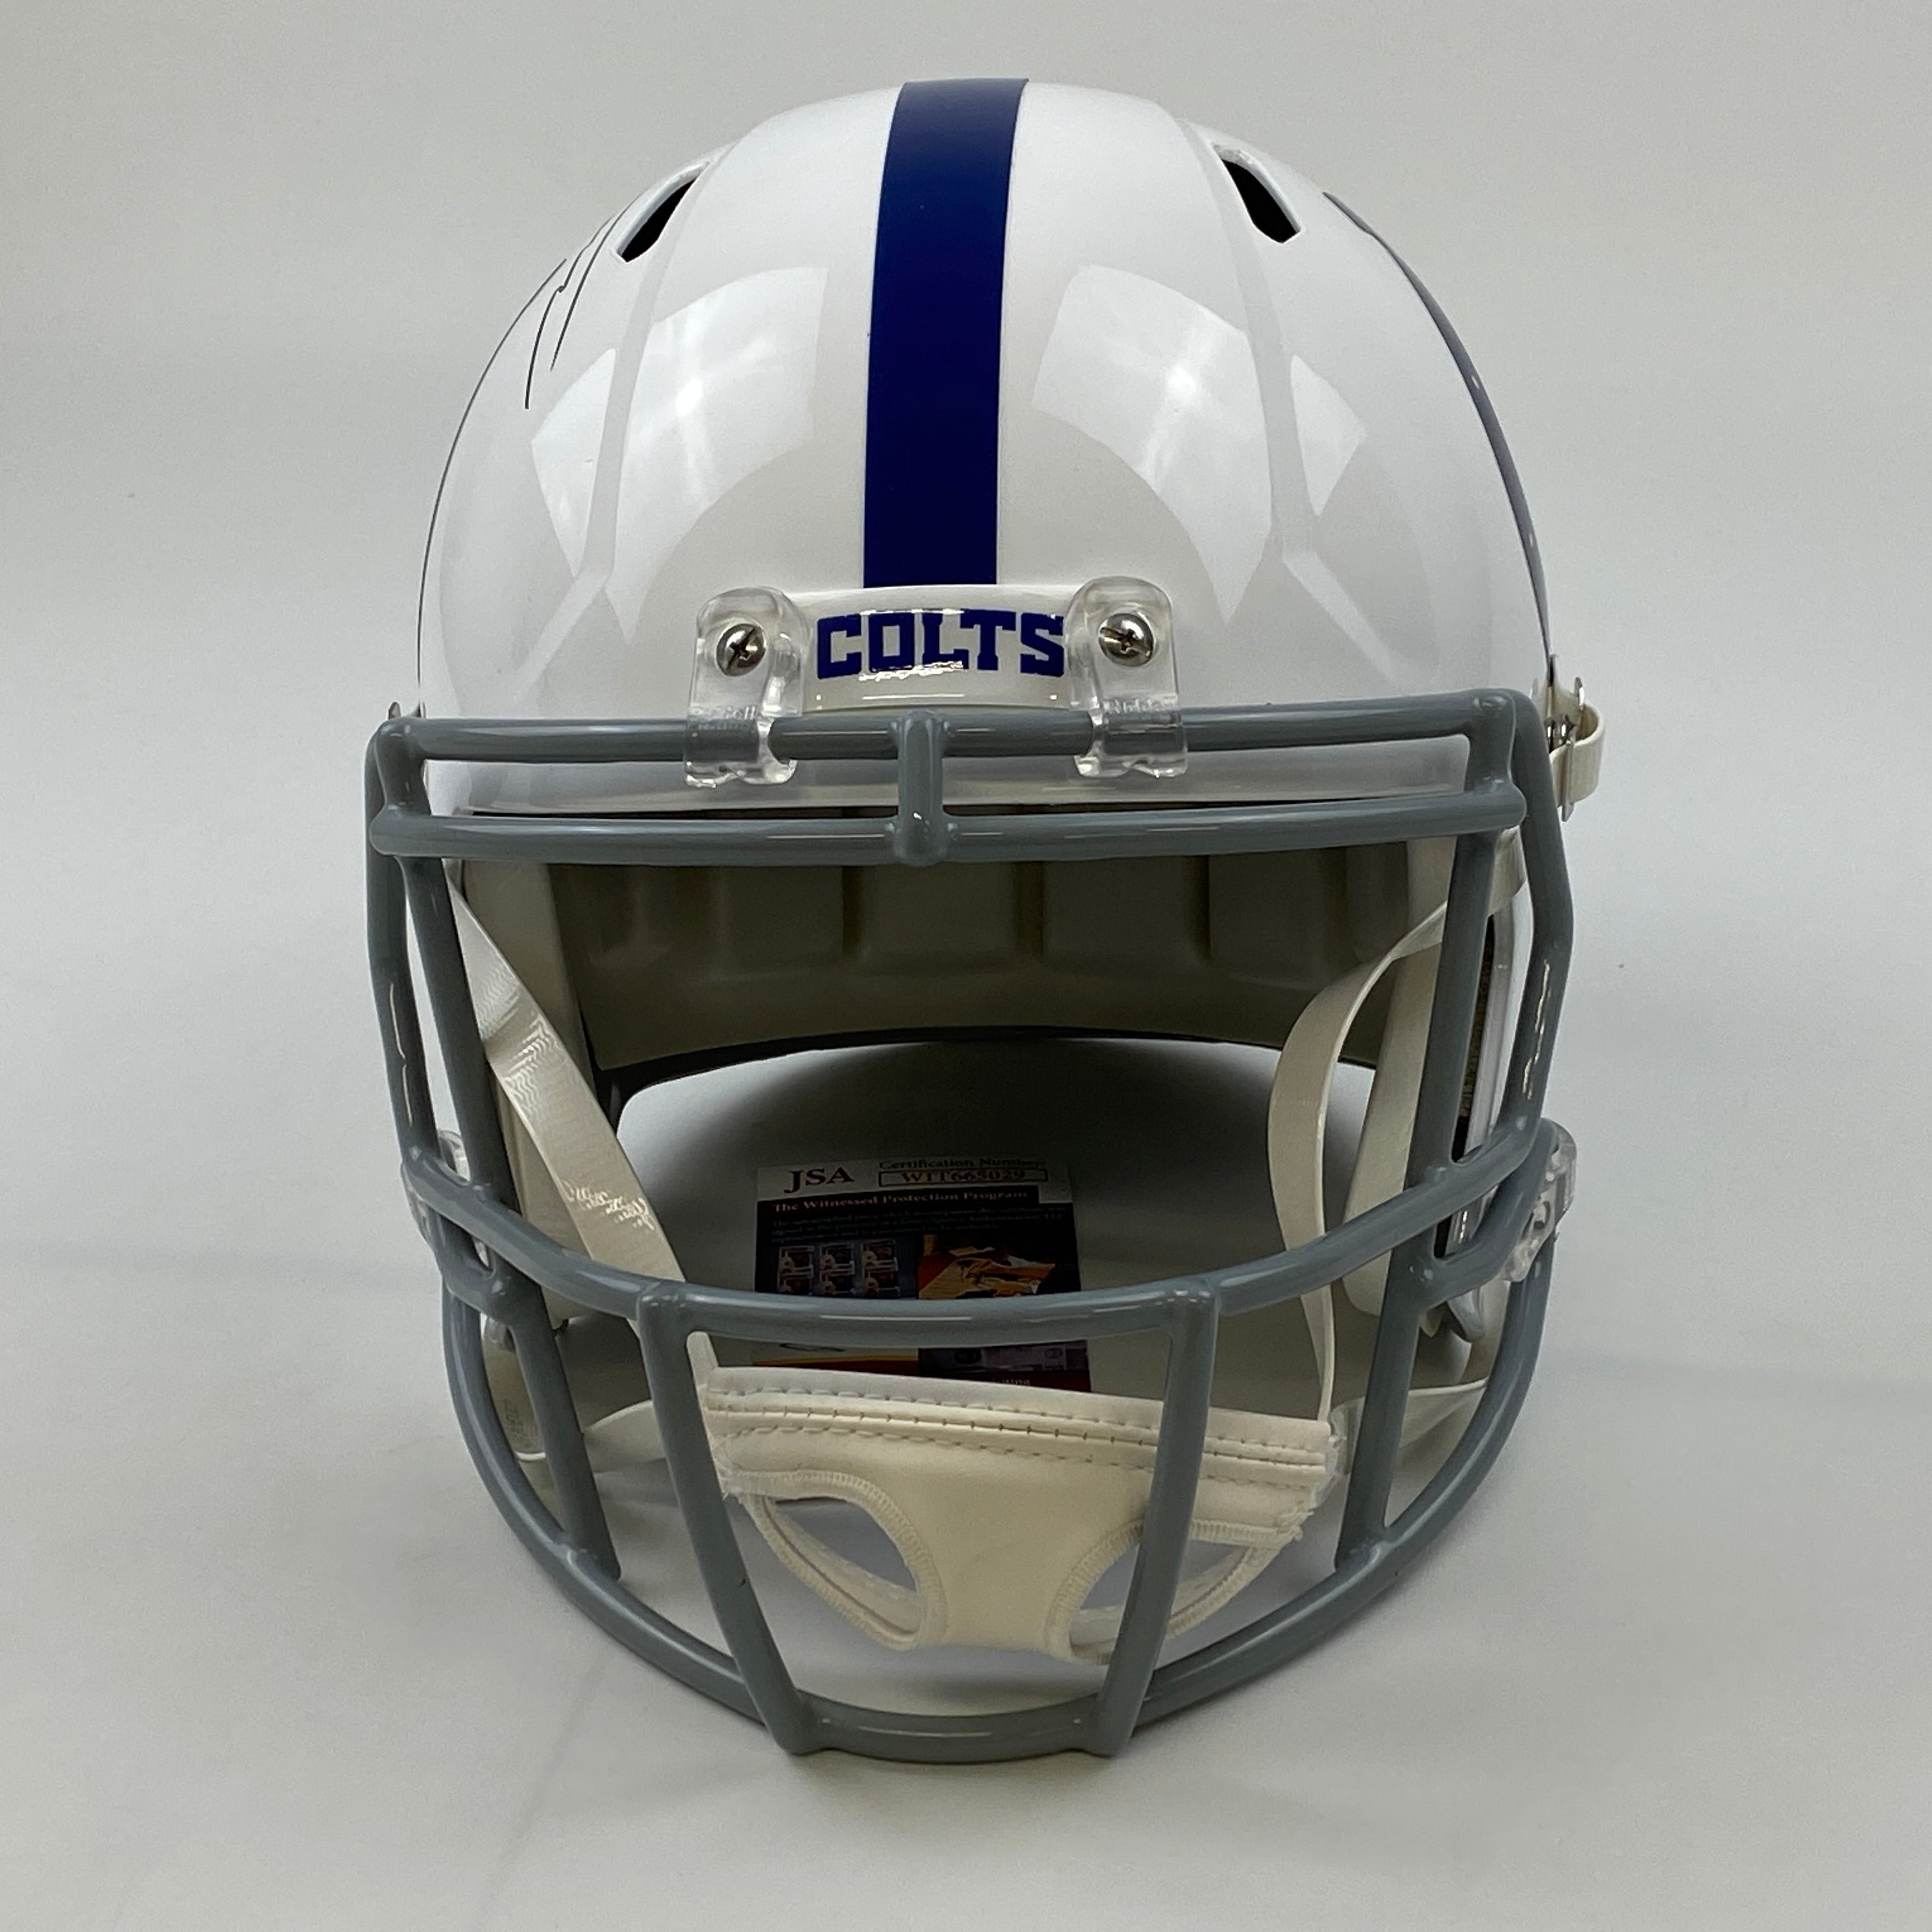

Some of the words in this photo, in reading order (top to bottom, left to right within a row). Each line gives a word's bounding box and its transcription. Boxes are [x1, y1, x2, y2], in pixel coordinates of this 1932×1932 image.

[817, 609, 1064, 679] COLTS
[879, 1159, 975, 1170] Certification
[784, 1167, 855, 1193] JSA
[774, 1202, 799, 1213] The
[803, 1196, 878, 1209] Witnessed
[883, 1193, 960, 1204] Protection
[963, 1190, 1027, 1201] Program
